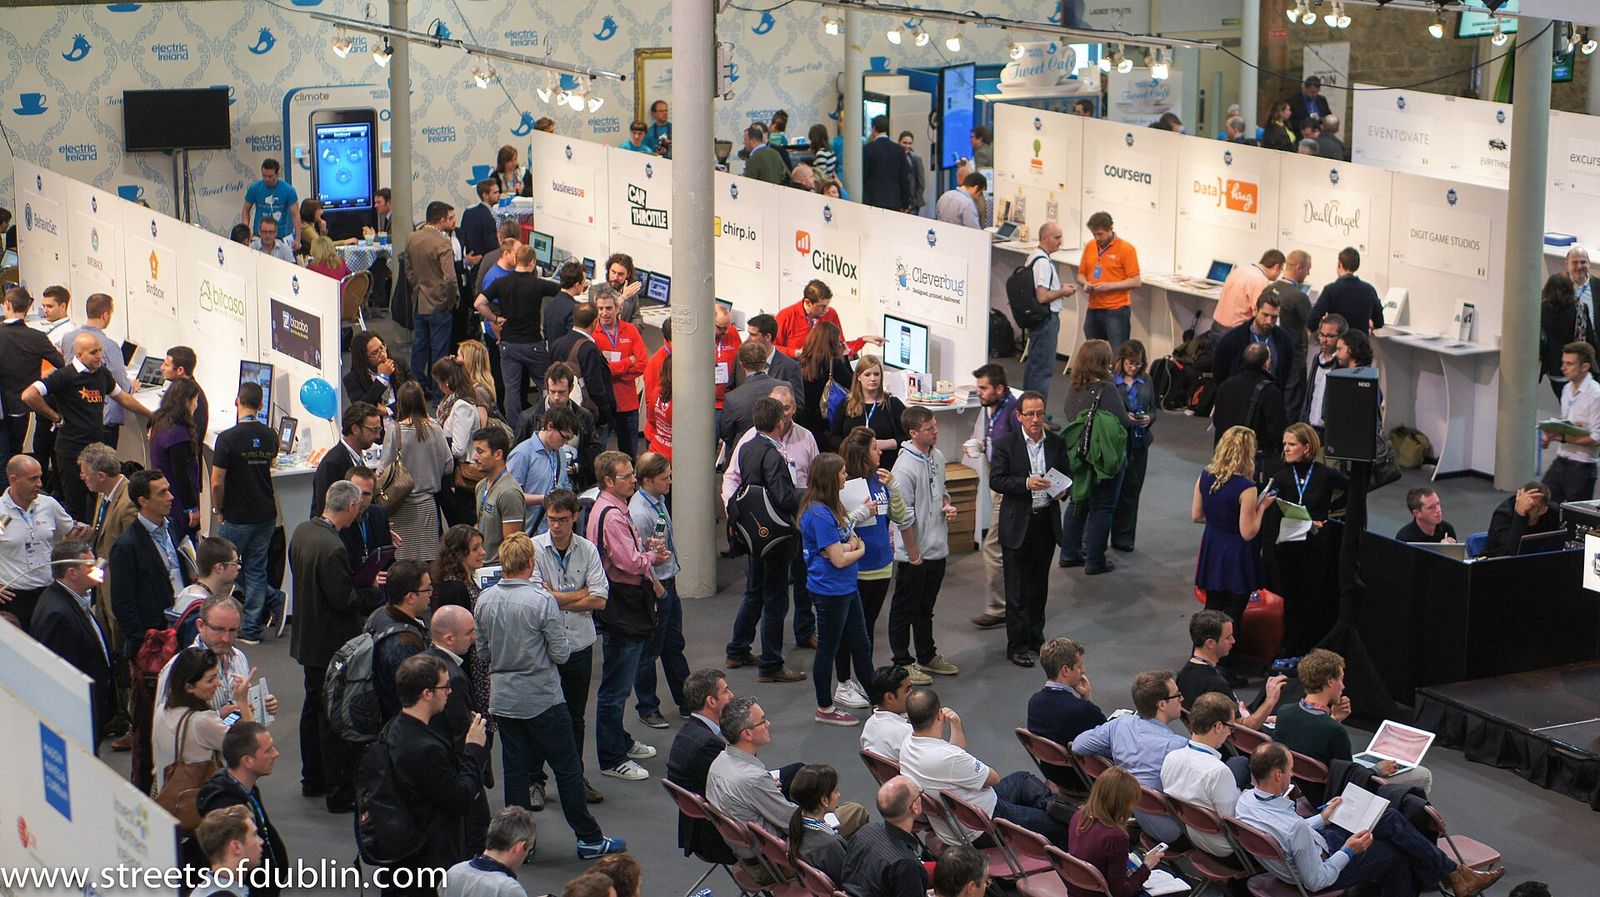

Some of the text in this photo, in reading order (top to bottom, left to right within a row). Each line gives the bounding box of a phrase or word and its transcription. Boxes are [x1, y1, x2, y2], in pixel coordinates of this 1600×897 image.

[505, 29, 538, 38] electric
[152, 42, 188, 52] electric
[510, 38, 538, 47] Ireland
[157, 51, 189, 61] Ireland
[1007, 57, 1045, 80] Tweet
[1319, 74, 1337, 85] OIN
[294, 91, 330, 102] climote
[588, 116, 620, 126] electric
[421, 125, 455, 135] electric
[592, 124, 620, 134] Ireland
[245, 134, 281, 145] electric
[427, 133, 456, 143] Ireland
[1368, 125, 1430, 145] EVENTOVATE
[59, 144, 96, 154] electric
[251, 142, 282, 152] Ireland
[65, 151, 97, 162] Ireland
[1104, 164, 1152, 185] coursera
[200, 186, 224, 197] Tweet
[629, 186, 645, 206] CAR
[1193, 180, 1254, 211] Data hug
[633, 208, 667, 228] THROTTLE
[1303, 199, 1361, 237] DealAngel
[723, 221, 756, 241] chirp.io
[1410, 228, 1480, 250] DIGIT GAME STUDIOS
[812, 249, 857, 280] CitiVox
[911, 266, 965, 297] Cleverbug
[212, 285, 245, 316] bitcasa
[290, 314, 309, 334] bizzabo
